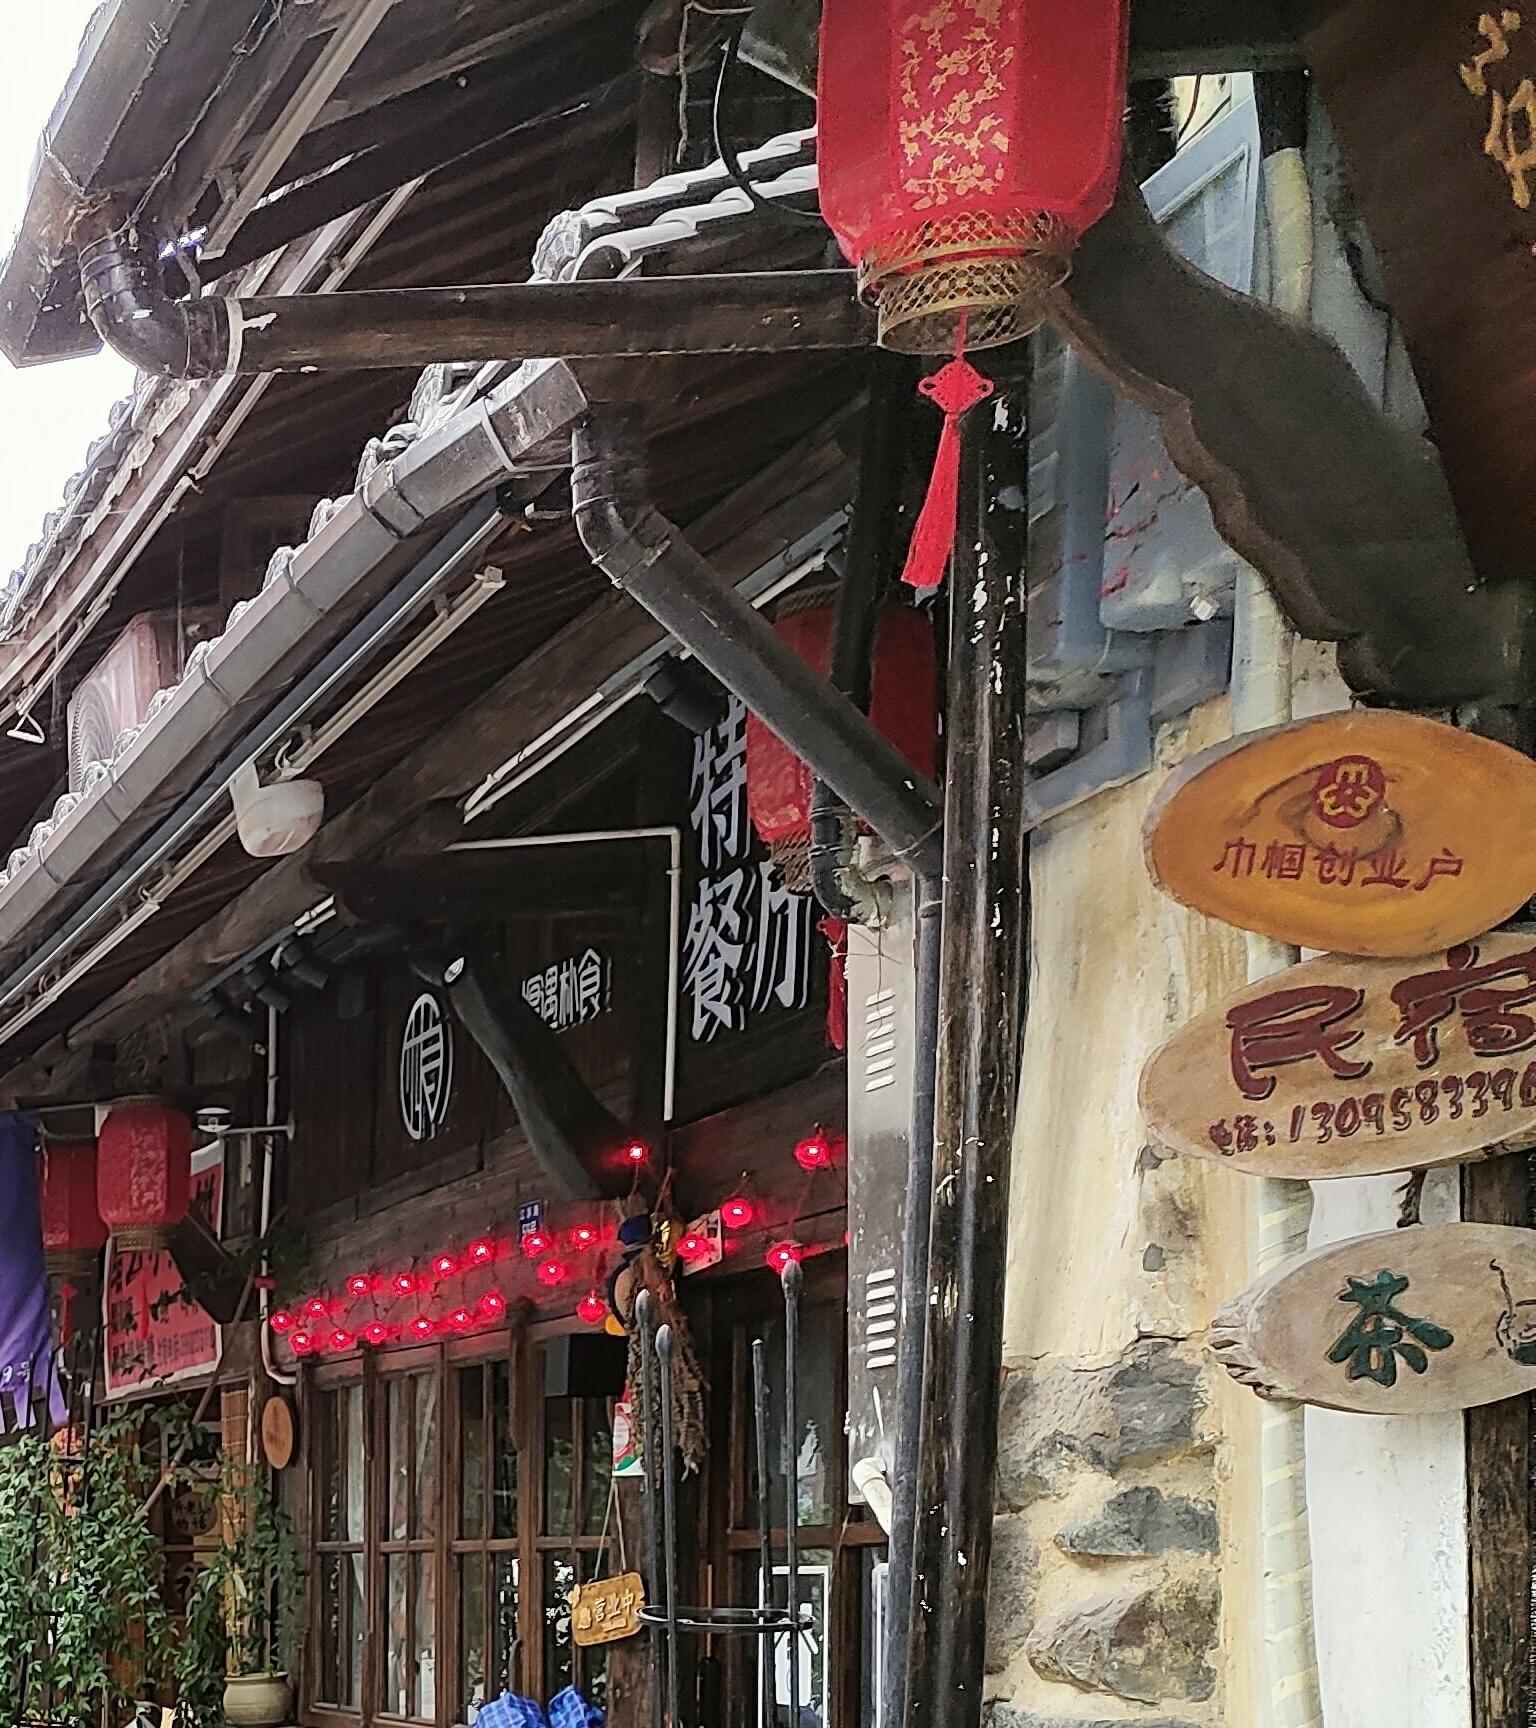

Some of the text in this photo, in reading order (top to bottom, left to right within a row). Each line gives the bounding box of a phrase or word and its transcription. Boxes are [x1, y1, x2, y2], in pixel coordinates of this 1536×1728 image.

[1213, 840, 1464, 892] 巾帼创业户
[1330, 1268, 1455, 1388] 茶
[593, 1587, 636, 1623] 营业中
